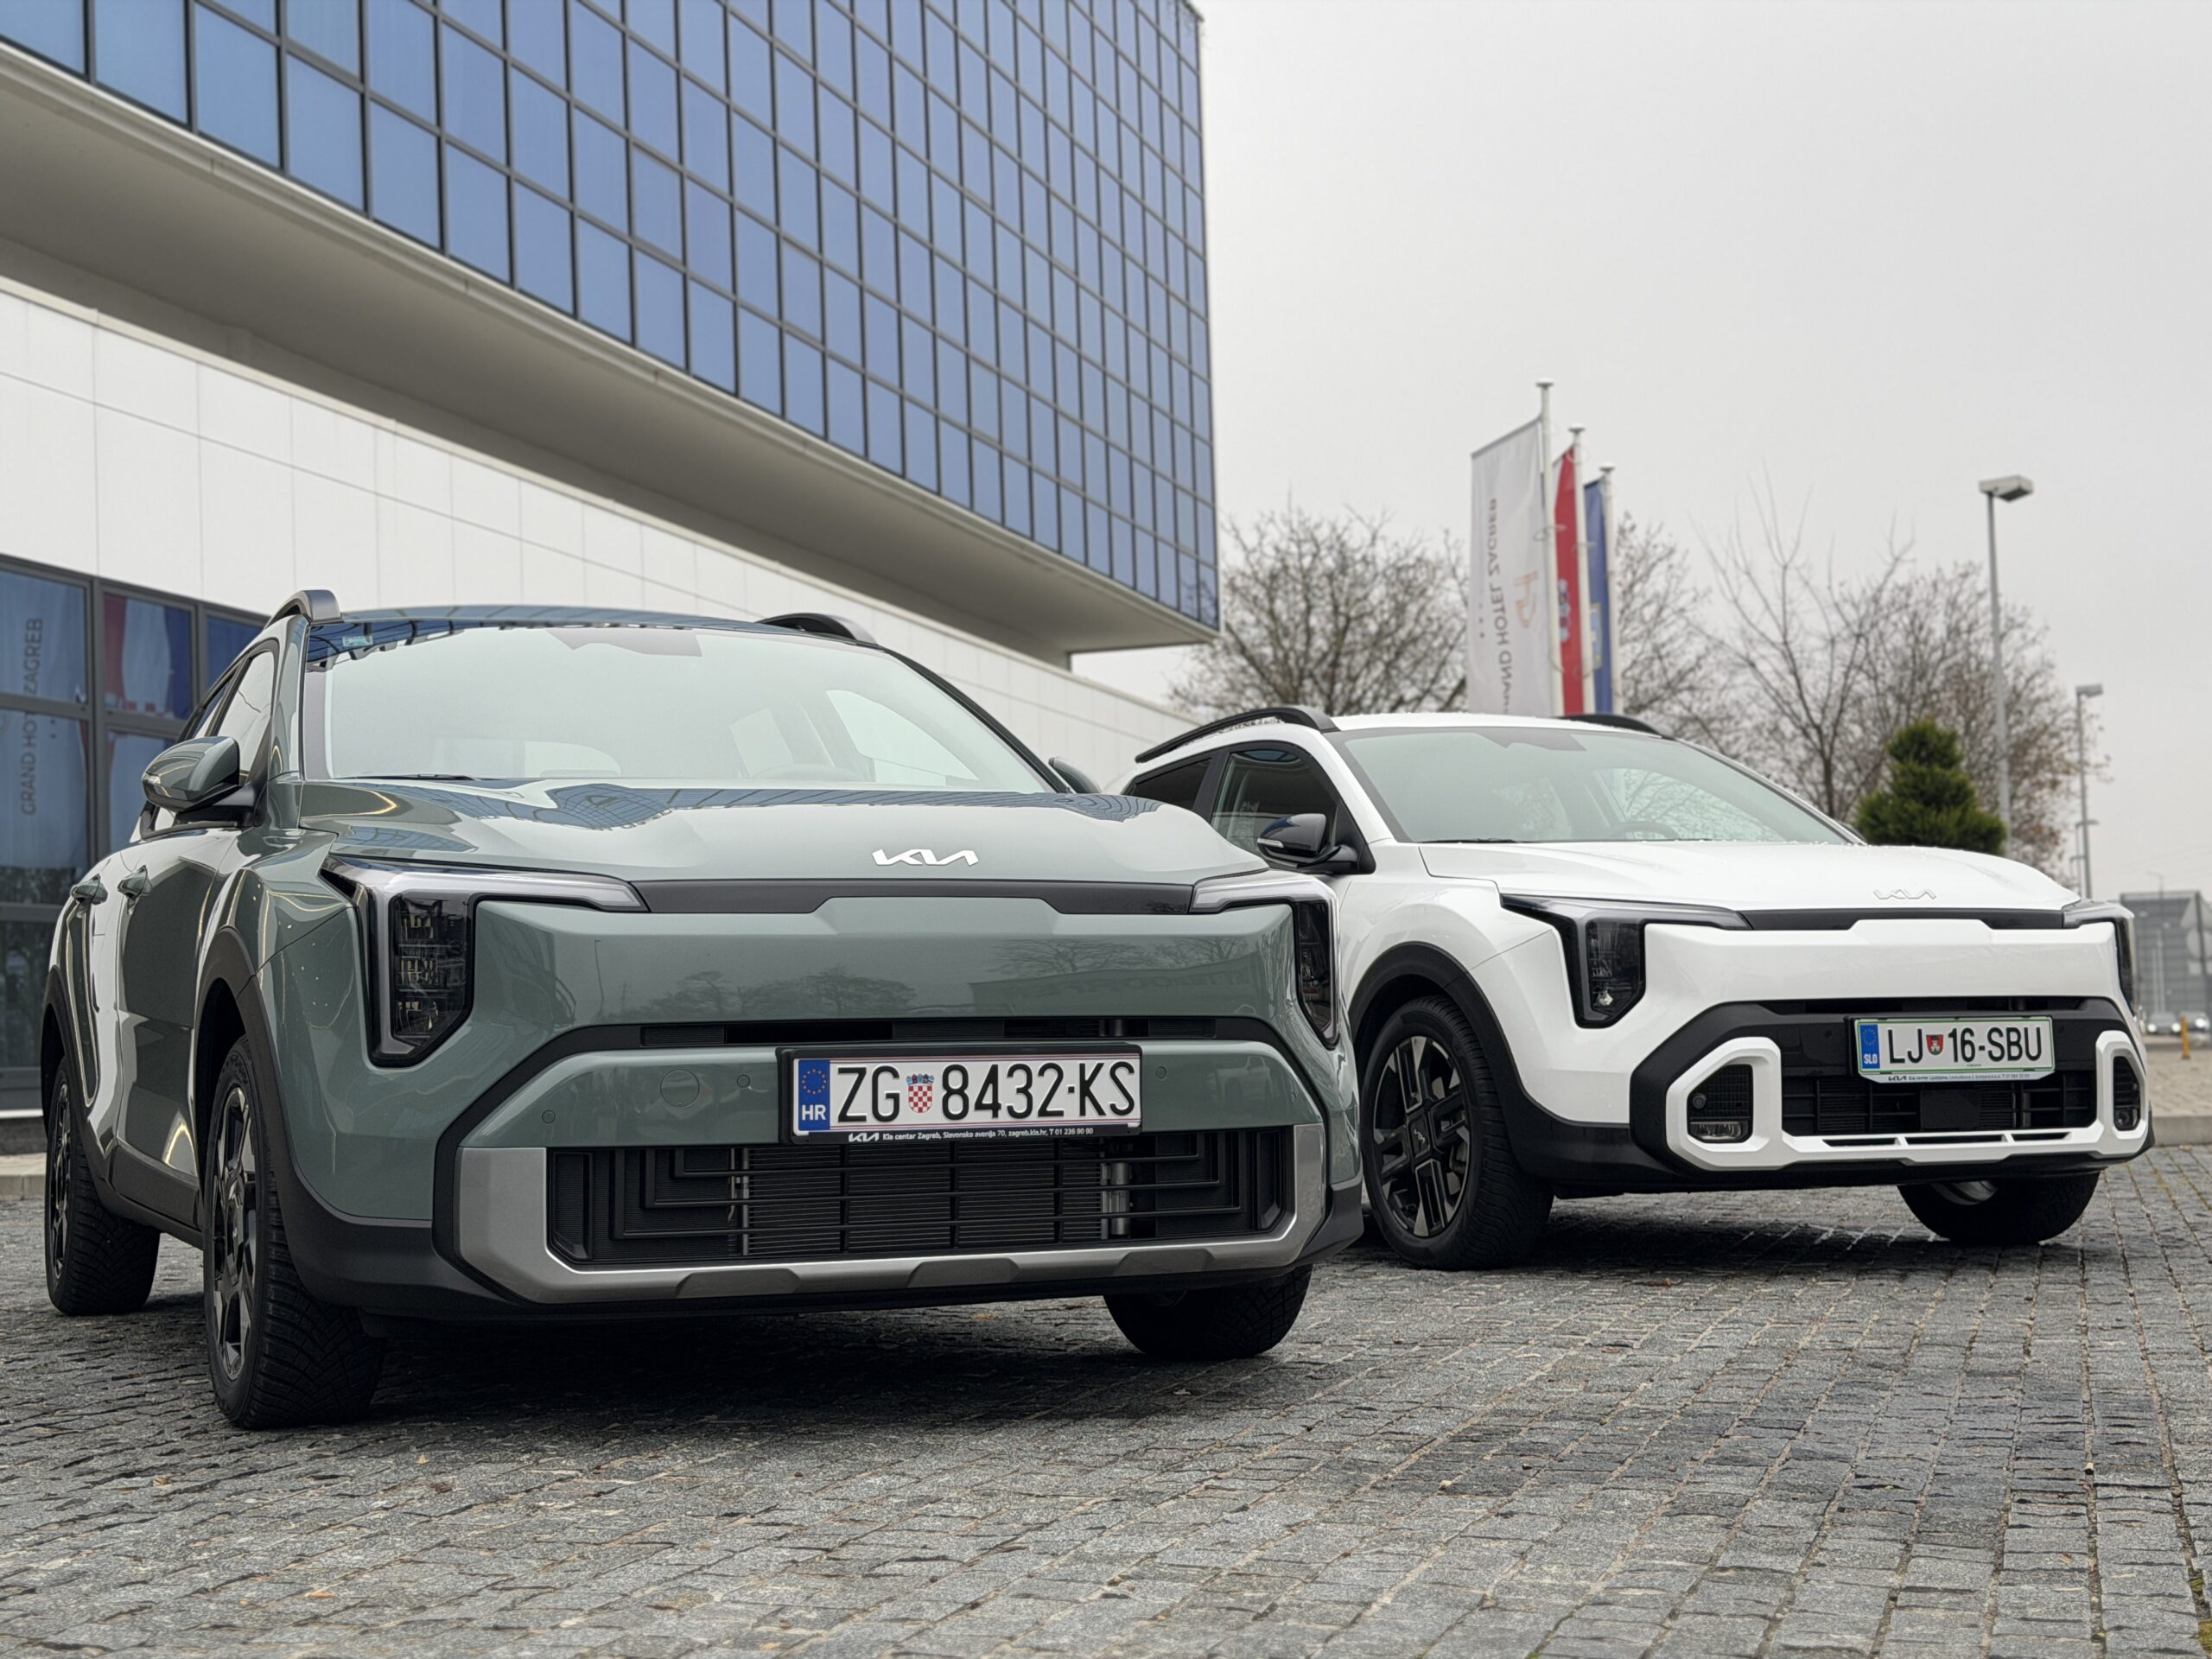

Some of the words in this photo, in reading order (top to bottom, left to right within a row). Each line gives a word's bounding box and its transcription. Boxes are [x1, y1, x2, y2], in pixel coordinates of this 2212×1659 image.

[23, 618, 42, 695] ZAGREB
[21, 752, 36, 816] GRAND
[872, 849, 979, 866] KIA
[1864, 1053, 1878, 1064] SLO
[1887, 1028, 1923, 1064] LJ
[1948, 1027, 2042, 1063] 16-SBU
[837, 1065, 900, 1122] ZG
[802, 1104, 826, 1121] HR
[848, 1132, 880, 1142] KIA
[918, 1131, 941, 1140] Zagreb,
